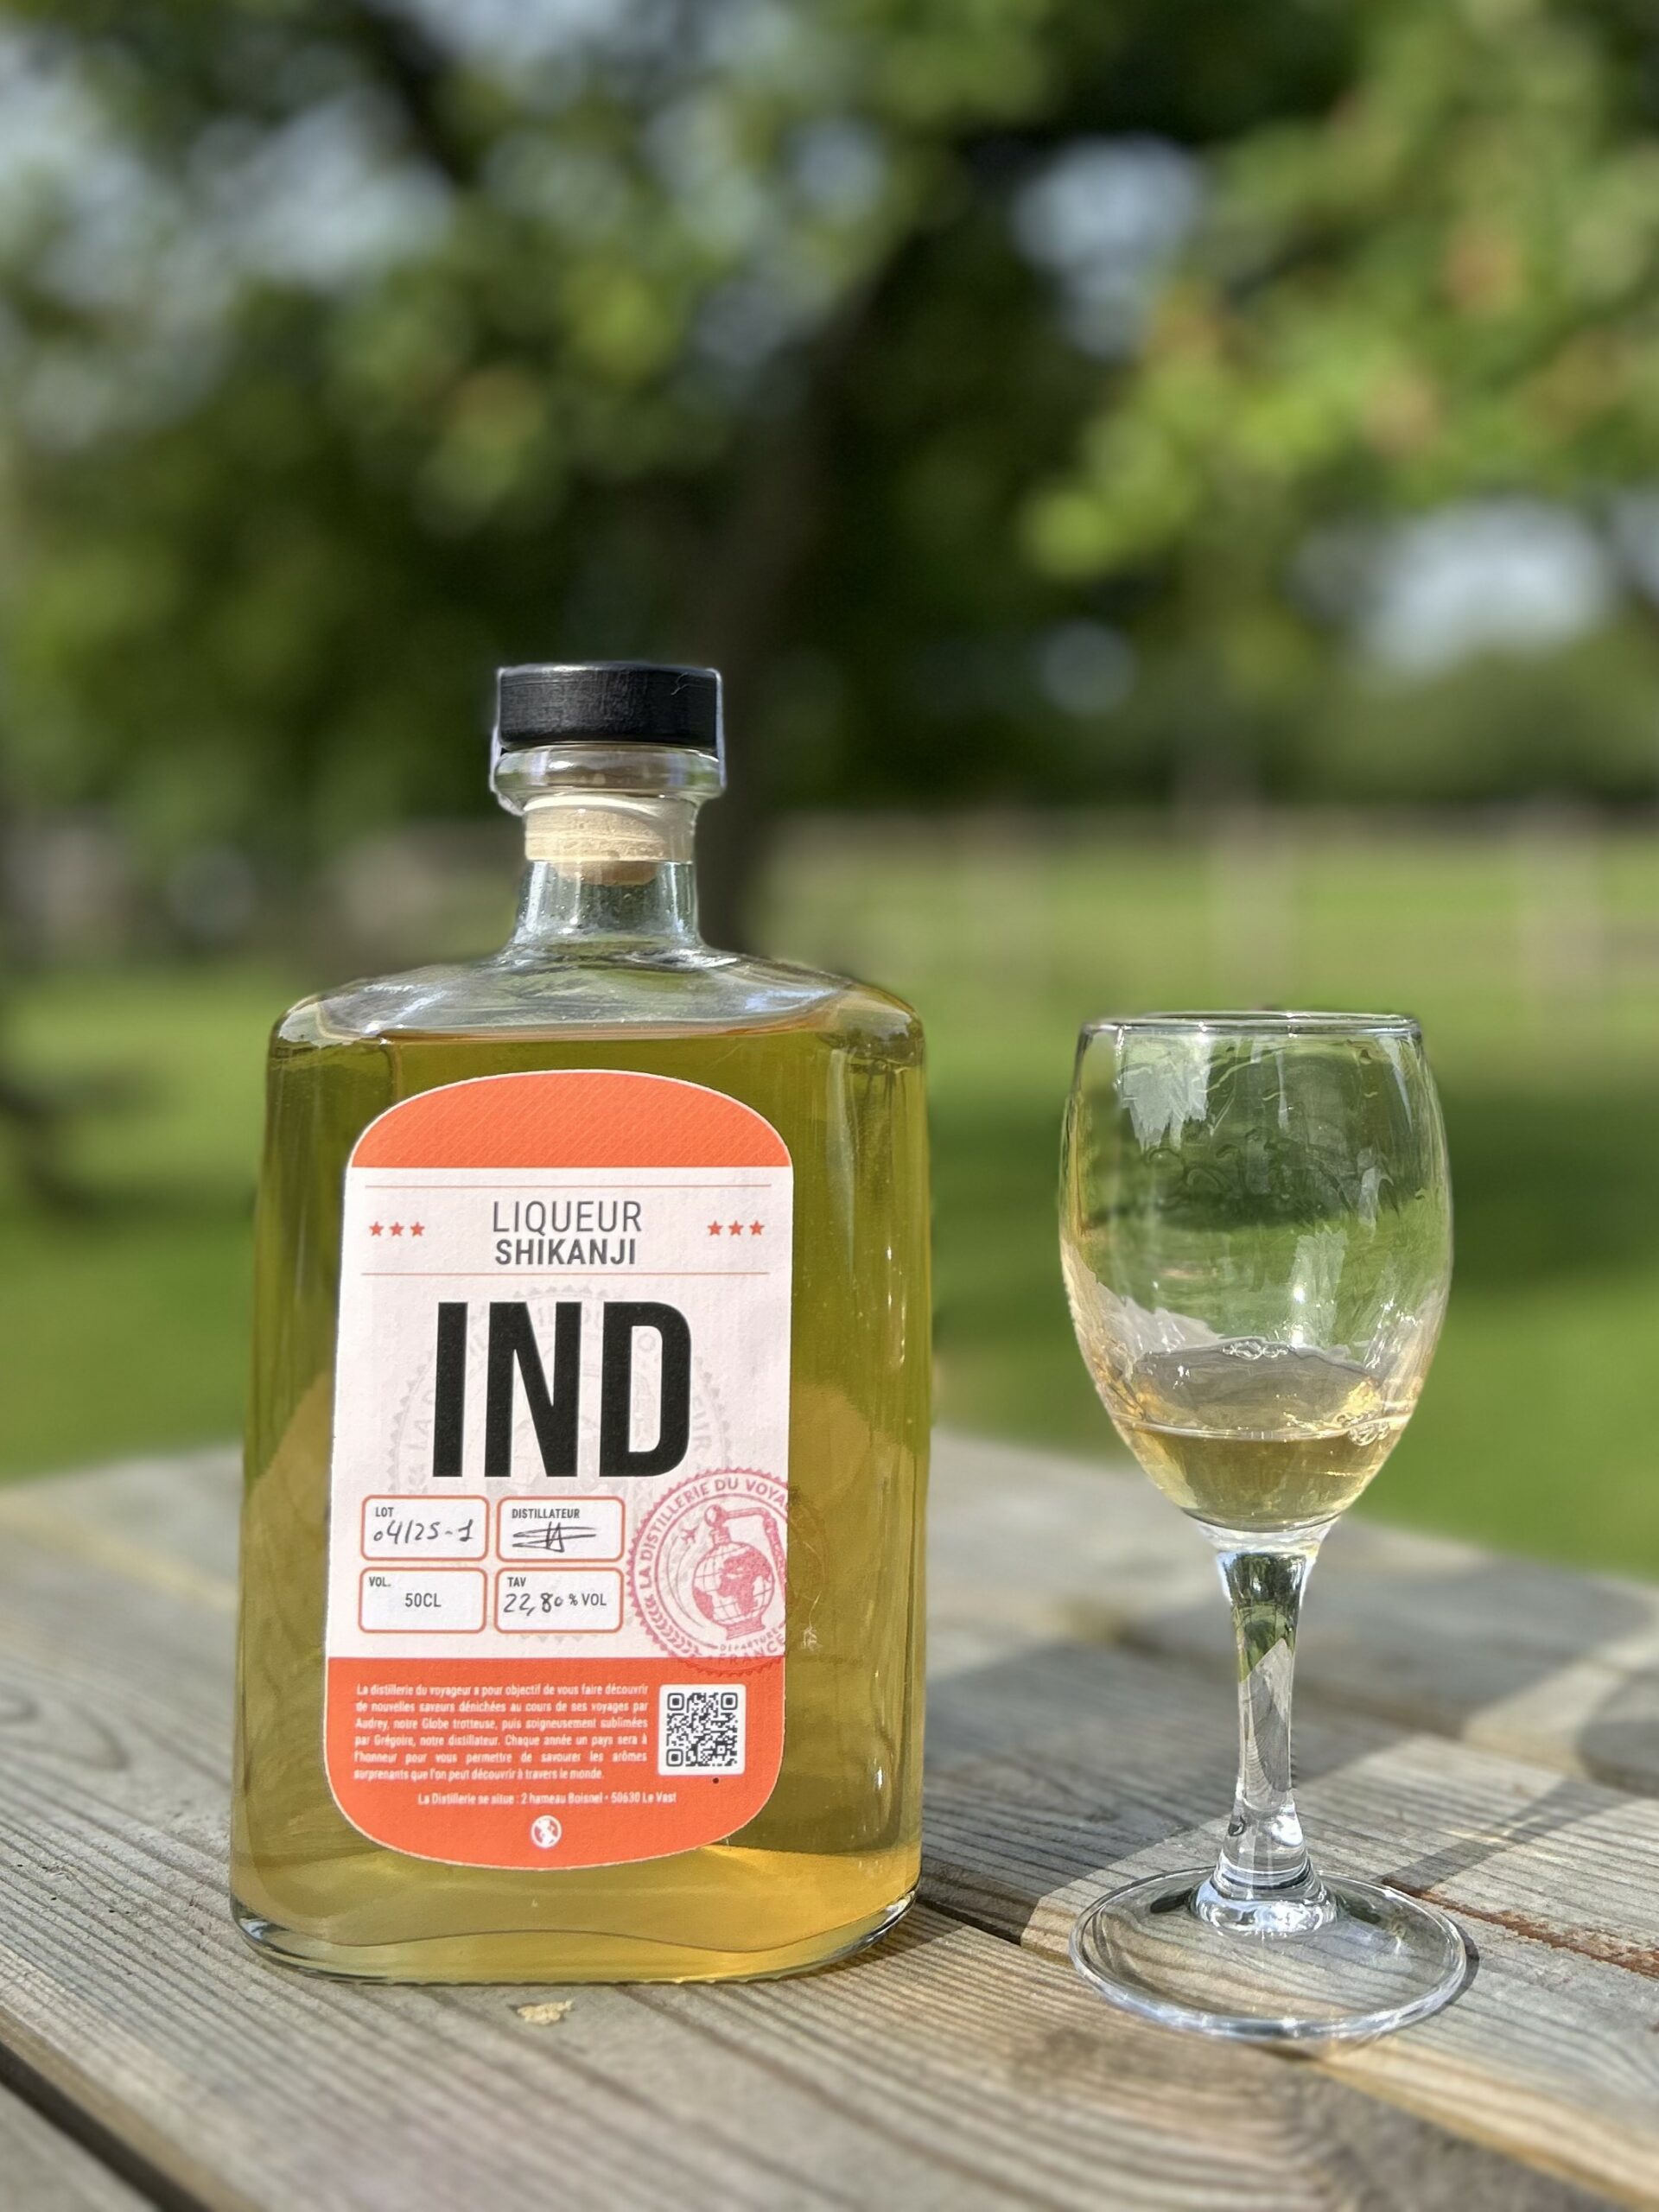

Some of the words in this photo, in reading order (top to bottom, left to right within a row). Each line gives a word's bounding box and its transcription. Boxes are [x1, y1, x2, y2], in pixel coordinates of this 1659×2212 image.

[493, 1200, 642, 1236] LIQUEUR
[495, 1238, 636, 1265] SHIKANJI
[432, 1301, 692, 1478] IND
[375, 1506, 394, 1517] LOT
[512, 1508, 581, 1519] DISTILLATEUR
[639, 1484, 710, 1561] DISTILLERIE
[715, 1478, 738, 1491] DU
[368, 1576, 391, 1587] VOL.
[507, 1576, 527, 1588] TAV
[404, 1592, 442, 1608] 50CL
[503, 1592, 563, 1617] 22,80
[582, 1592, 607, 1606] VOL
[356, 1684, 368, 1695] La
[371, 1684, 413, 1695] distillerie
[416, 1684, 427, 1695] du
[429, 1687, 471, 1698] voyageur
[474, 1687, 480, 1695] a
[482, 1687, 502, 1697] pour
[505, 1683, 541, 1697] objectif
[543, 1684, 554, 1694] de
[557, 1686, 578, 1694] vous
[582, 1684, 602, 1694] faire
[606, 1683, 648, 1694] découvrir
[355, 1701, 367, 1712] de
[372, 1701, 415, 1712] nouvelles
[419, 1703, 454, 1712] saveurs
[459, 1701, 505, 1712] dénichées
[511, 1703, 521, 1712] au
[525, 1703, 551, 1712] cours
[556, 1701, 567, 1712] de
[571, 1703, 587, 1712] ses
[592, 1702, 628, 1713] voyages
[633, 1702, 648, 1713] par
[355, 1718, 390, 1731] Audrey,
[394, 1719, 417, 1729] notre
[422, 1718, 449, 1729] Globe
[502, 1719, 521, 1731] puis
[526, 1718, 595, 1731] soigneusement
[601, 1718, 648, 1728] sublimées
[355, 1737, 370, 1746] par
[374, 1735, 416, 1748] Grégoire,
[420, 1737, 444, 1745] notre
[505, 1735, 539, 1746] Chaque
[543, 1735, 572, 1745] année
[575, 1737, 588, 1745] un
[592, 1737, 613, 1746] pays
[641, 1733, 646, 1745] à
[405, 1753, 427, 1765] pour
[435, 1753, 457, 1763] vous
[467, 1753, 512, 1765] permettre
[521, 1751, 532, 1762] de
[541, 1753, 581, 1762] savourer
[590, 1751, 603, 1762] les
[613, 1751, 647, 1762] arômes
[354, 1770, 408, 1781] surprenants
[410, 1770, 428, 1781] que
[448, 1770, 470, 1781] peut
[472, 1769, 515, 1779] découvrir
[525, 1770, 557, 1779] travers
[560, 1769, 568, 1779] le
[418, 1794, 429, 1804] La
[432, 1793, 475, 1804] Distillerie
[478, 1795, 489, 1804] se
[491, 1794, 514, 1804] situe
[521, 1792, 526, 1804] 2
[530, 1792, 566, 1804] hameau
[611, 1792, 640, 1803] 50630
[643, 1792, 653, 1803] Le
[656, 1791, 677, 1803] Vast
